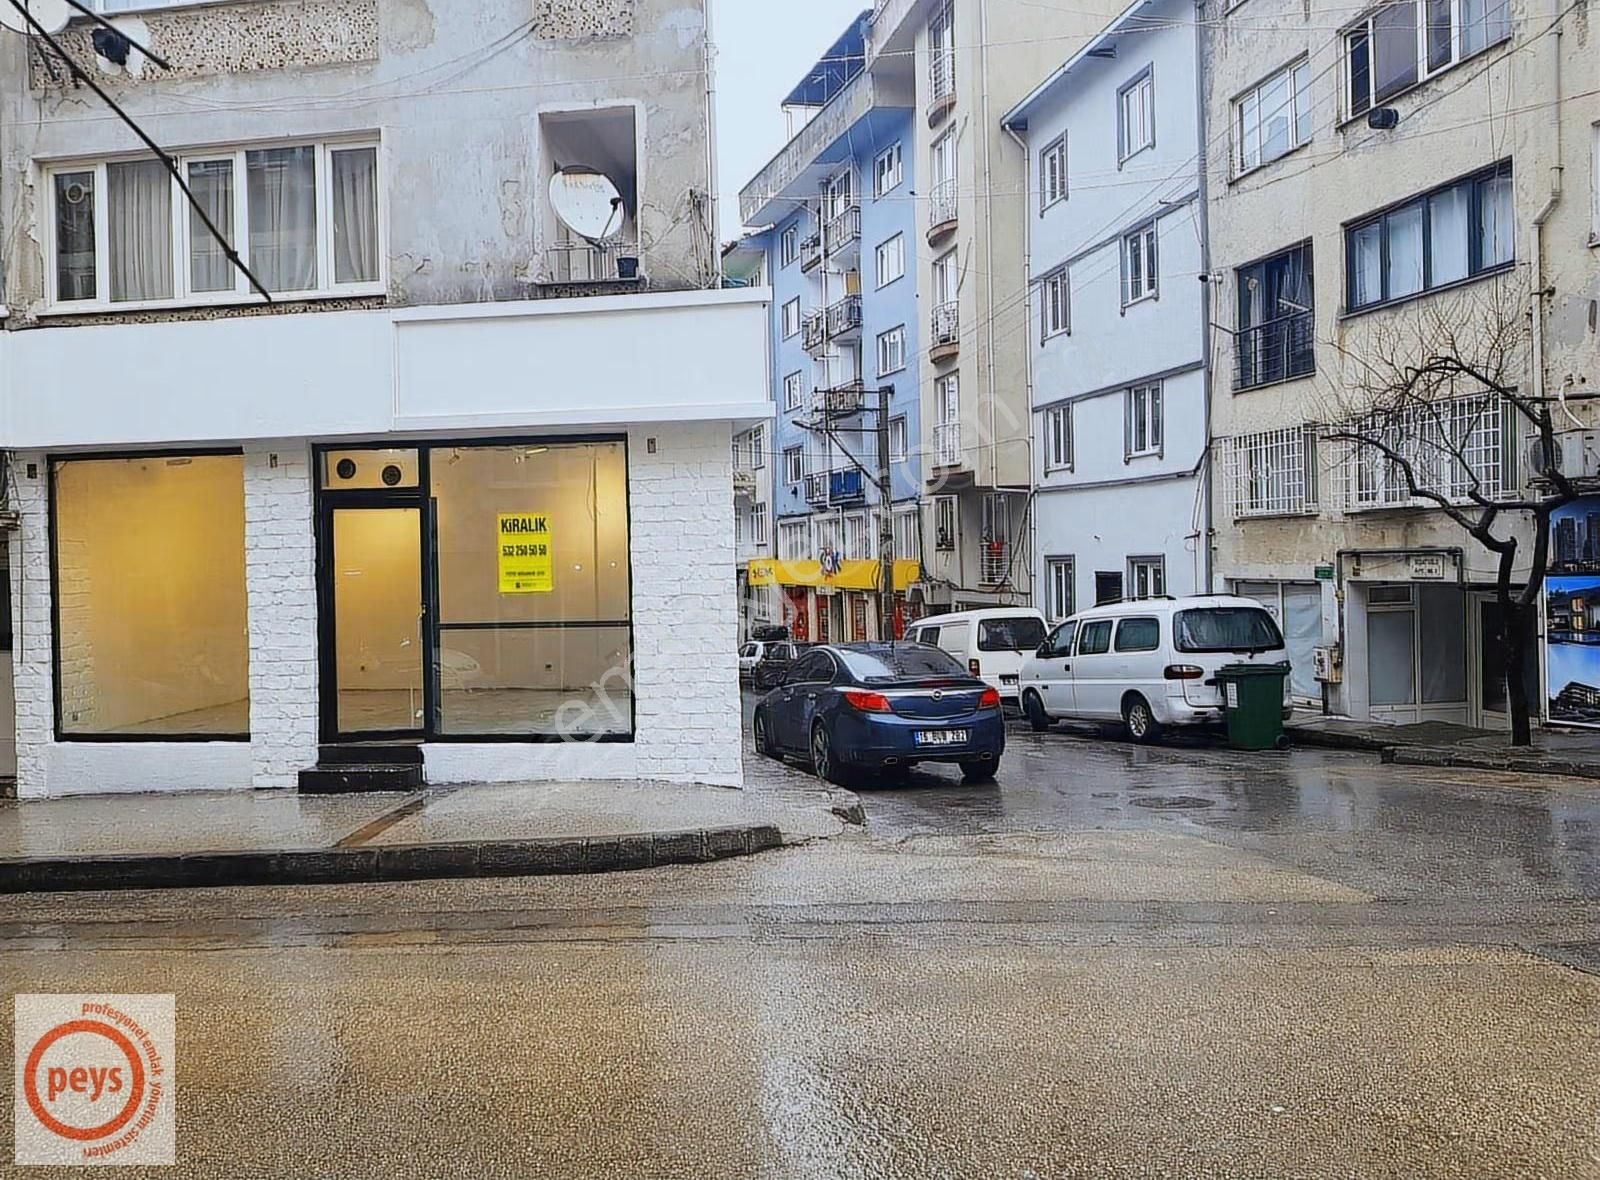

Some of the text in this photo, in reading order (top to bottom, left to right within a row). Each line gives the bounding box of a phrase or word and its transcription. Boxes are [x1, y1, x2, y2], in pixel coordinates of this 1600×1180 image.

[502, 545, 514, 556] 532
[516, 545, 527, 556] 250
[529, 544, 537, 556] 50
